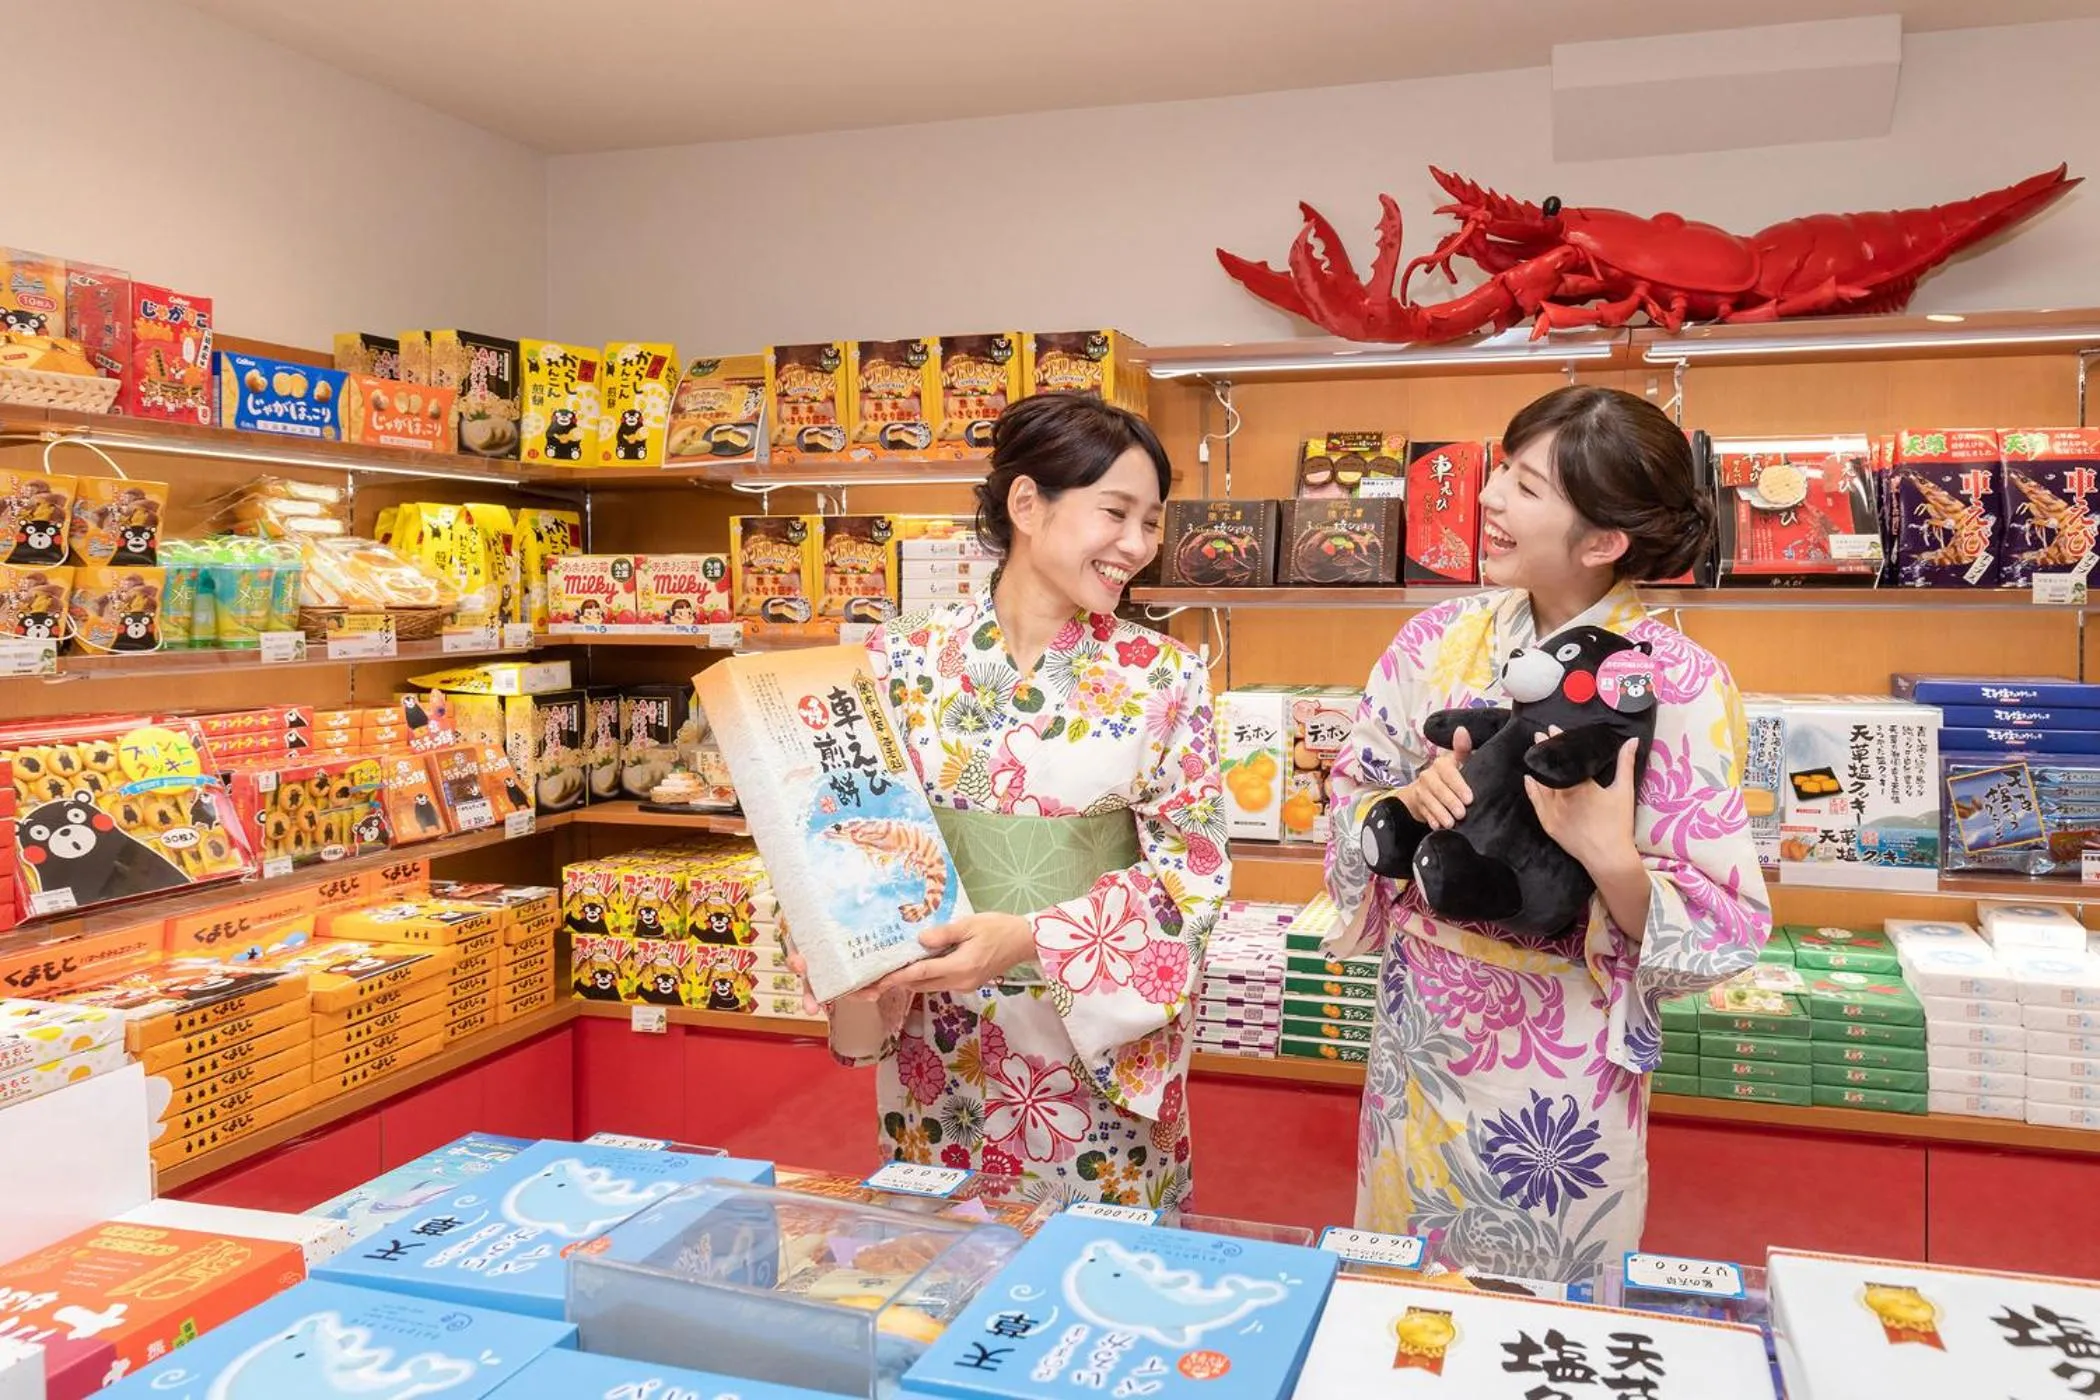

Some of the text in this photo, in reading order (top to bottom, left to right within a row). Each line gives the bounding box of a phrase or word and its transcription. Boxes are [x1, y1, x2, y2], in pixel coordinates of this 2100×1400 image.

[827, 686, 893, 796] 車えび
[1848, 724, 1874, 825] 天草塩クッキー
[194, 918, 251, 944] くまもと
[4, 956, 78, 988] くまもと
[953, 1312, 1040, 1371] 天草
